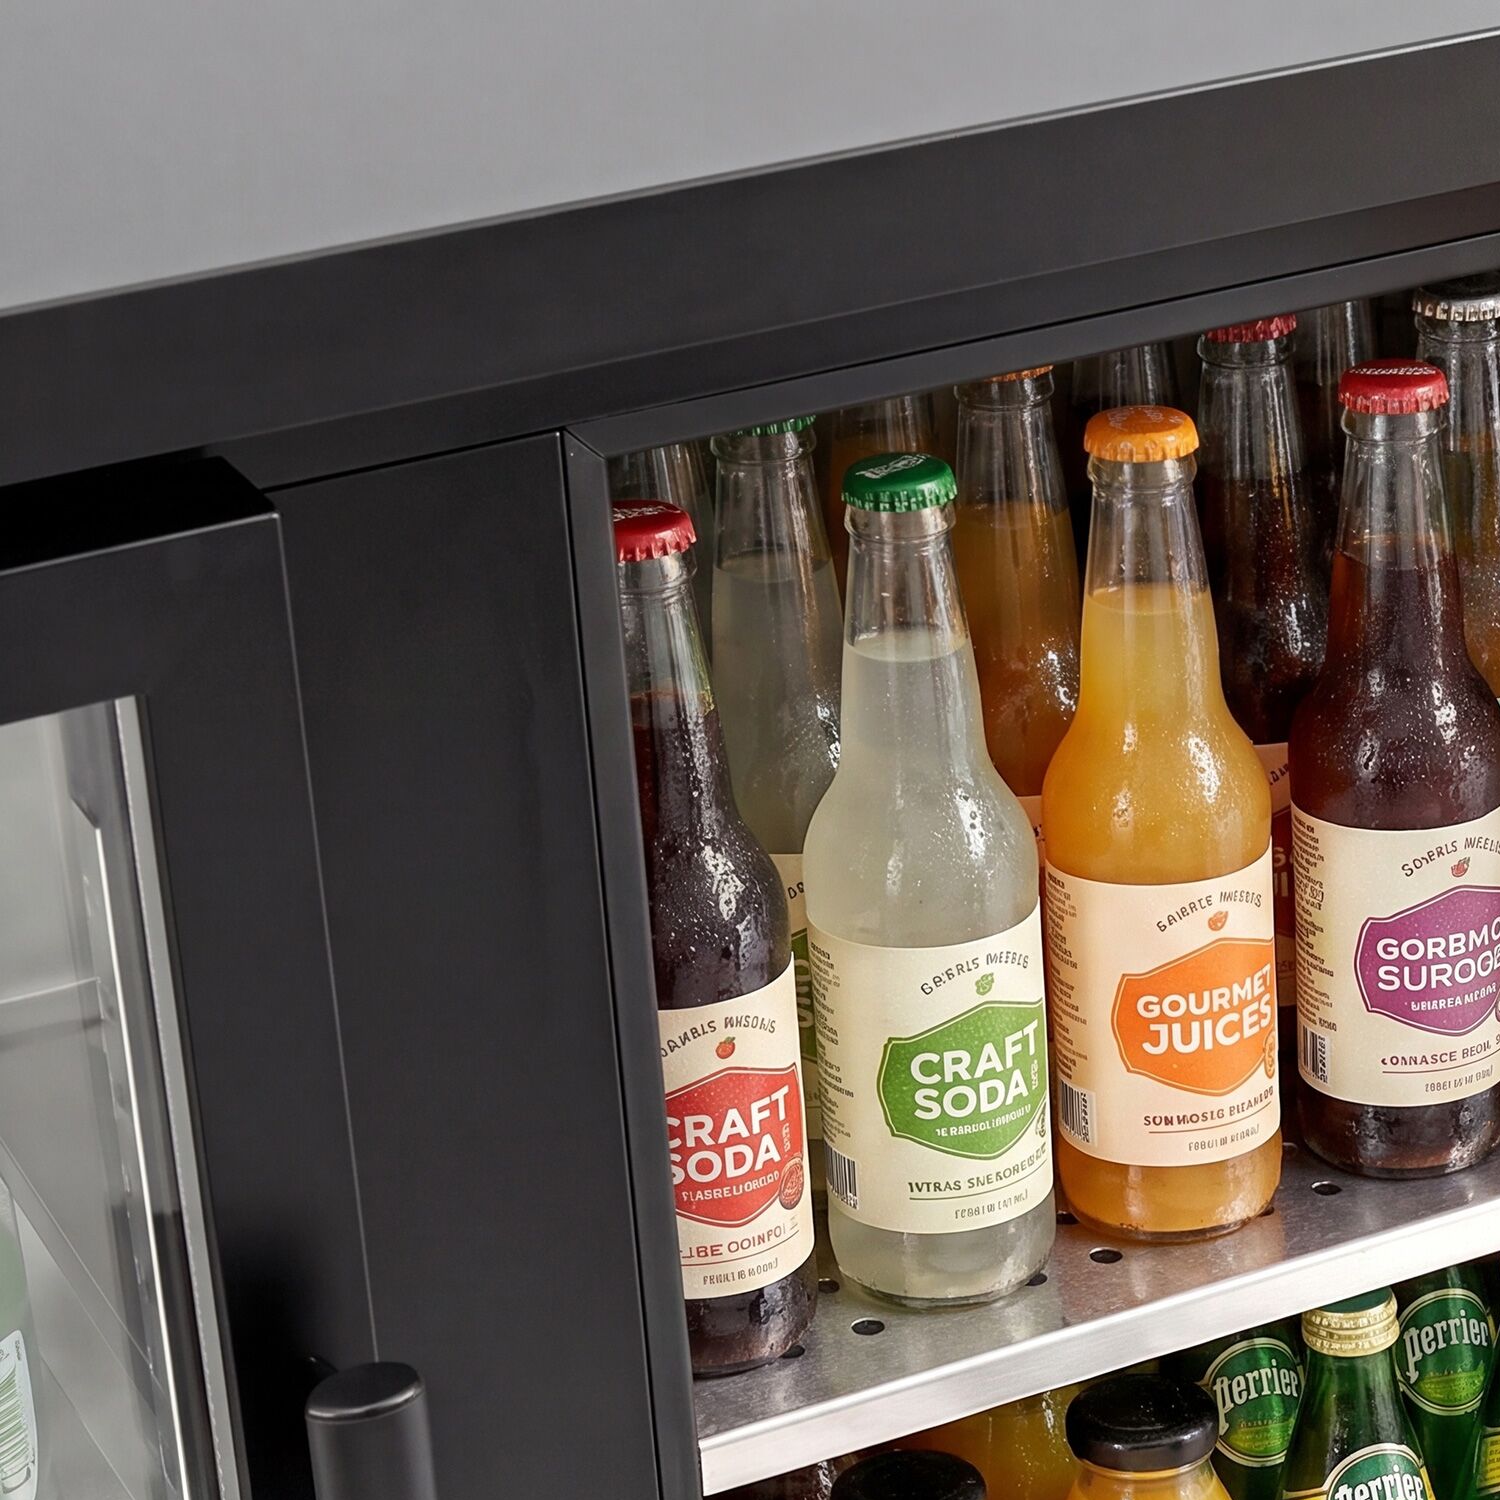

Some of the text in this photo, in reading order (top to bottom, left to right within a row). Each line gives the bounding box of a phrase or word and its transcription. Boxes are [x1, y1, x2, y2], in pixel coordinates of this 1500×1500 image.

[1136, 963, 1271, 1020] GOURMET
[910, 1018, 1039, 1085] CRAFT
[1141, 992, 1271, 1055] JUICES
[913, 1068, 1029, 1121] SODA
